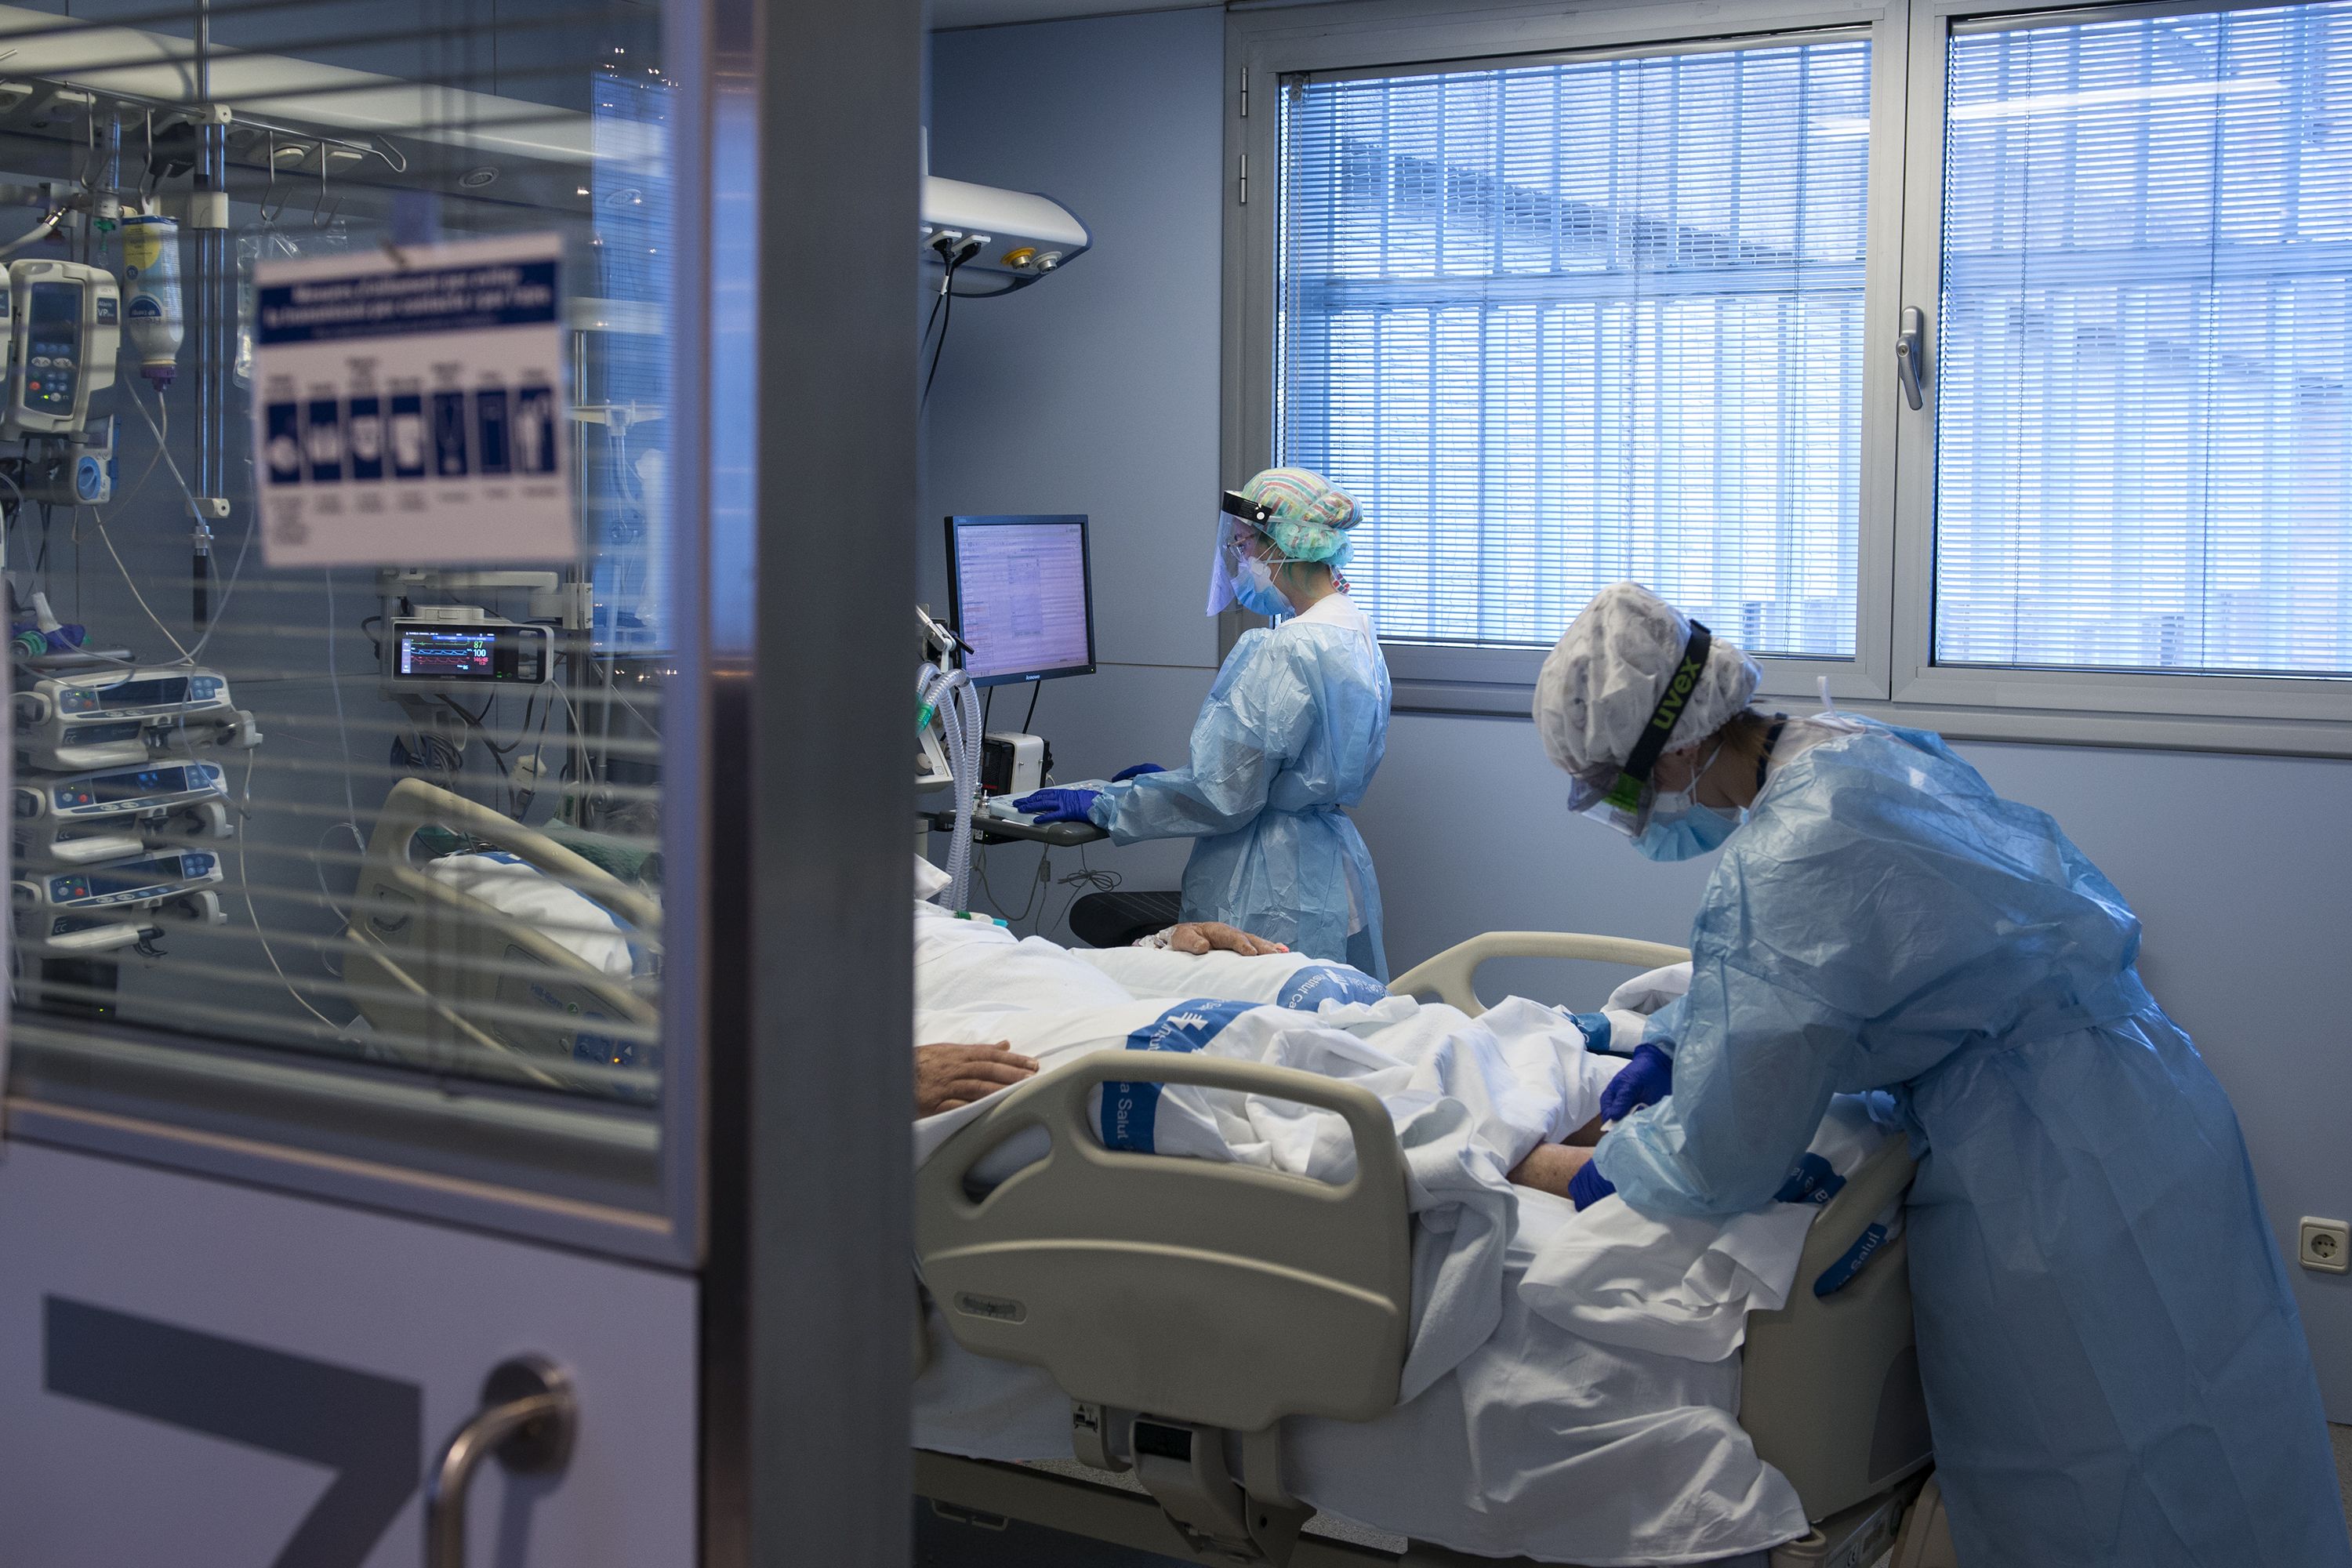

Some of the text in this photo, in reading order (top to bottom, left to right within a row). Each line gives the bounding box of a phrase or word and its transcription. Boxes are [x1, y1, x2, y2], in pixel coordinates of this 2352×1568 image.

[473, 648, 486, 657] 100
[474, 641, 483, 649] 87
[1653, 655, 1701, 730] uvex
[1116, 1098, 1133, 1140] Salut
[1850, 1230, 1880, 1272] Salut
[43, 1294, 422, 1568] 7
